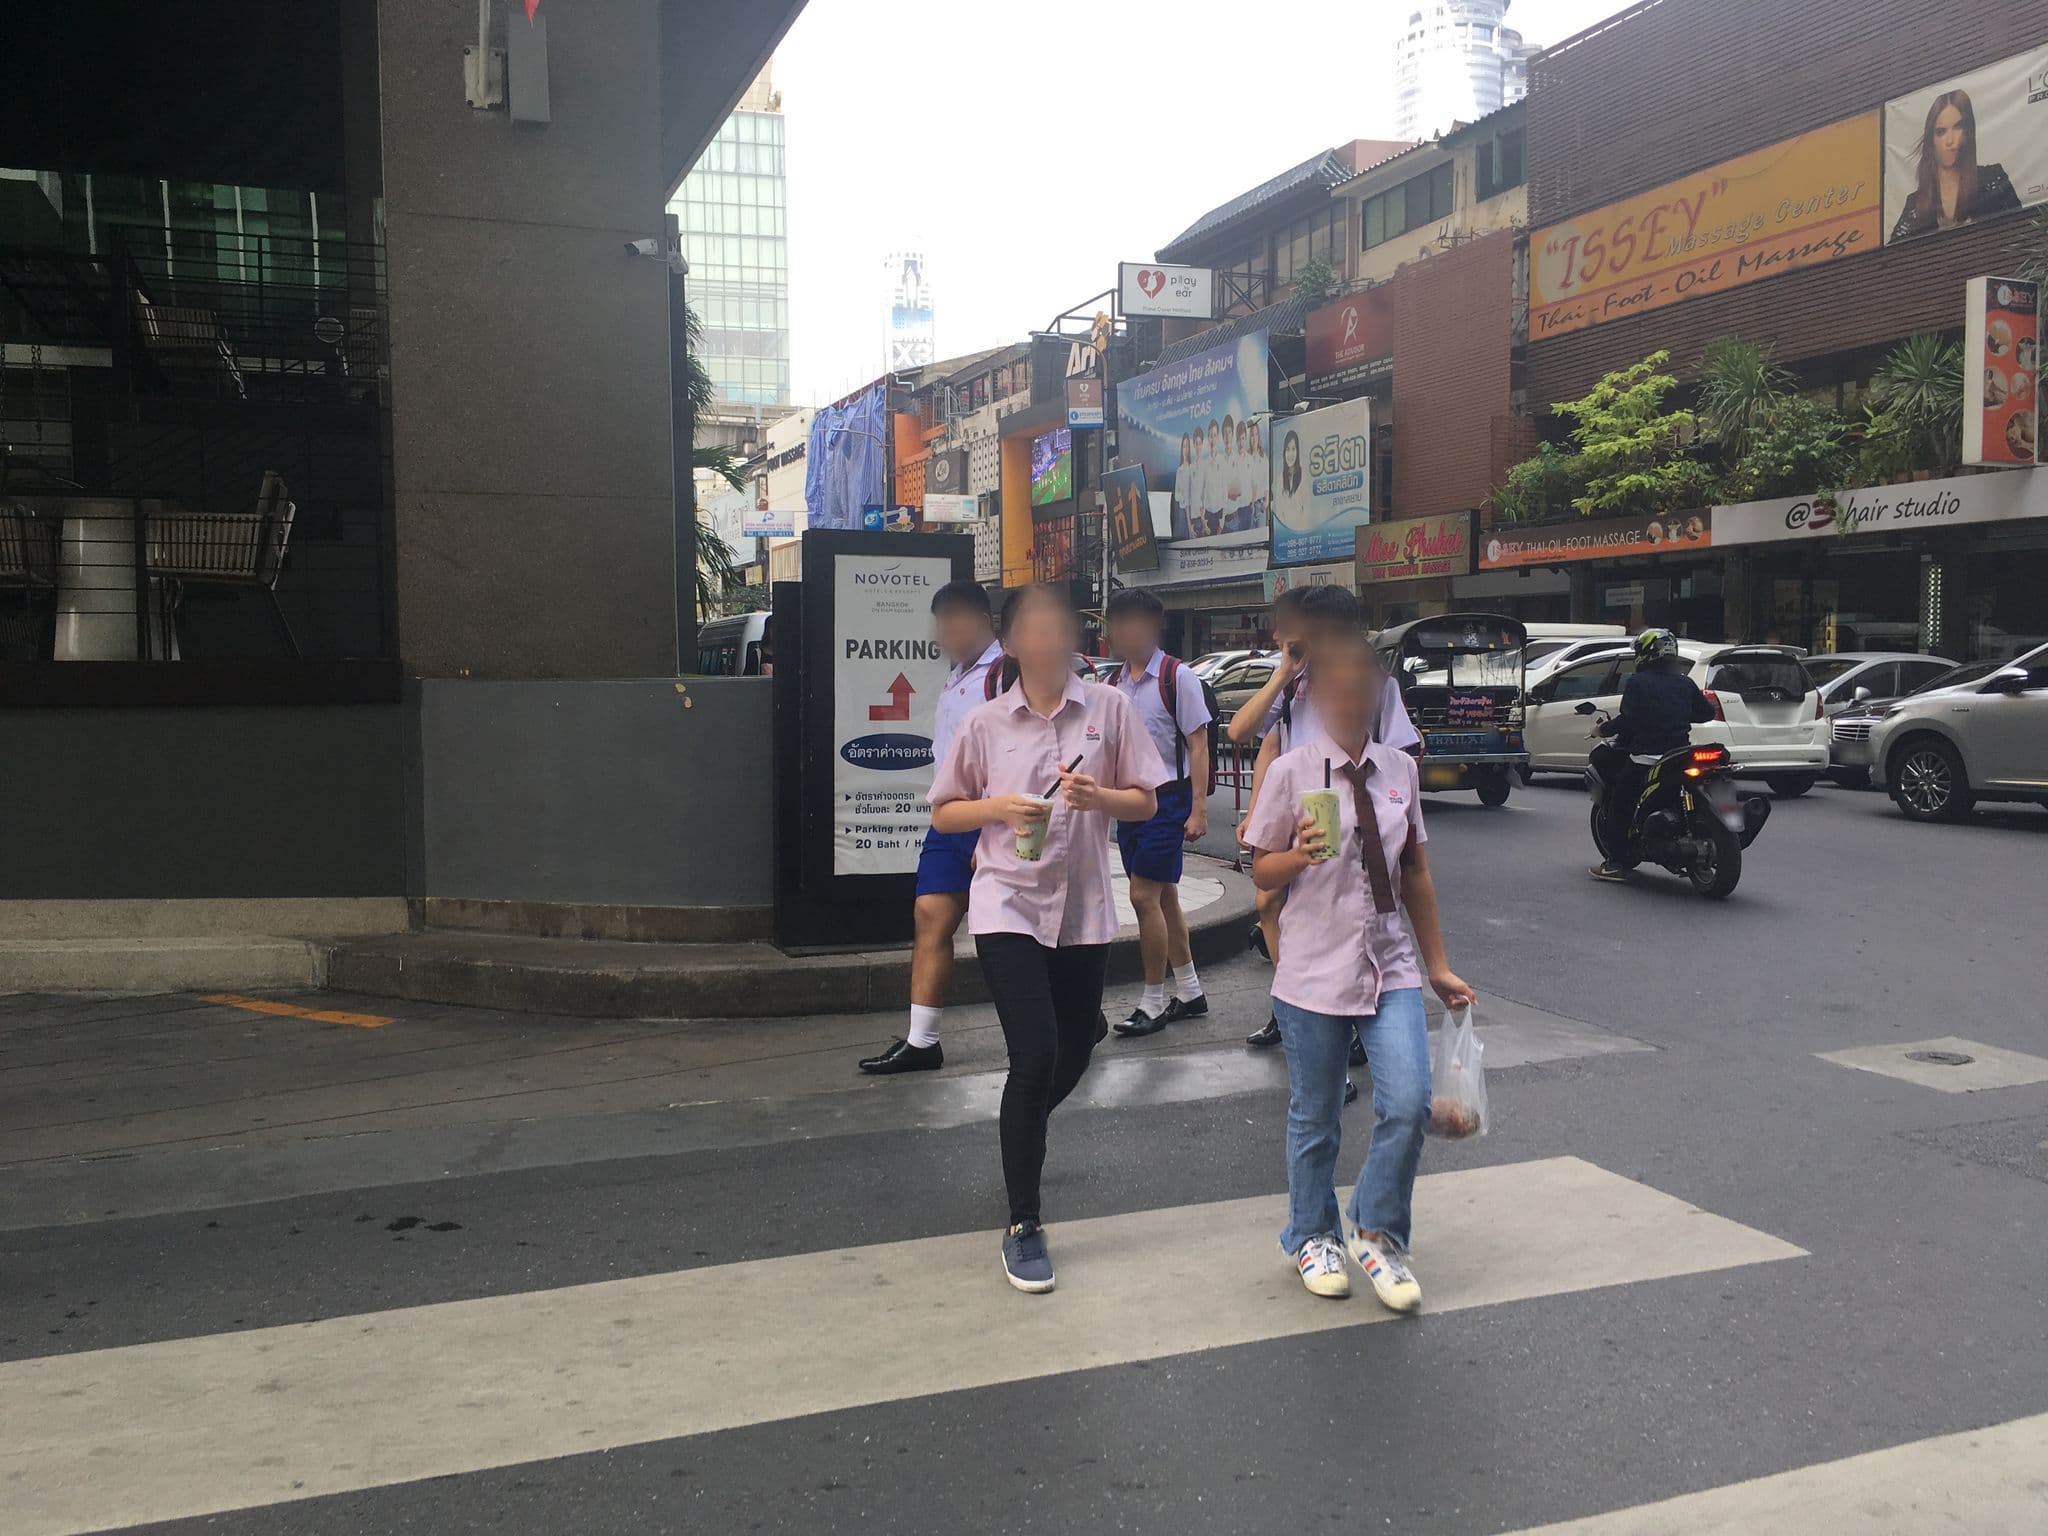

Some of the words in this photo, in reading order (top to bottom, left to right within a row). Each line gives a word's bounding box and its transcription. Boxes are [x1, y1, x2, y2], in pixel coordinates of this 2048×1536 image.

[1663, 212, 1766, 258] Massage
[1775, 181, 1865, 223] Center
[1537, 304, 1585, 333] Thai
[1603, 285, 1655, 316] Foot
[1675, 260, 1725, 294] Oil
[1736, 228, 1866, 277] Massage
[1175, 289, 1193, 298] ear
[1844, 496, 1889, 522] hair
[1893, 491, 1961, 520] studio
[1593, 529, 1641, 548] MASSAGE
[855, 573, 931, 587] NOVOTEL
[845, 639, 941, 661] PARKING
[855, 791, 915, 802] อัตราค่าจอดรถ
[855, 803, 890, 815] ชั่วโมงละ
[895, 803, 912, 814] 20
[855, 825, 894, 835] Parking
[898, 825, 919, 833] rate
[855, 839, 872, 850] 20
[877, 839, 901, 849] Baht
